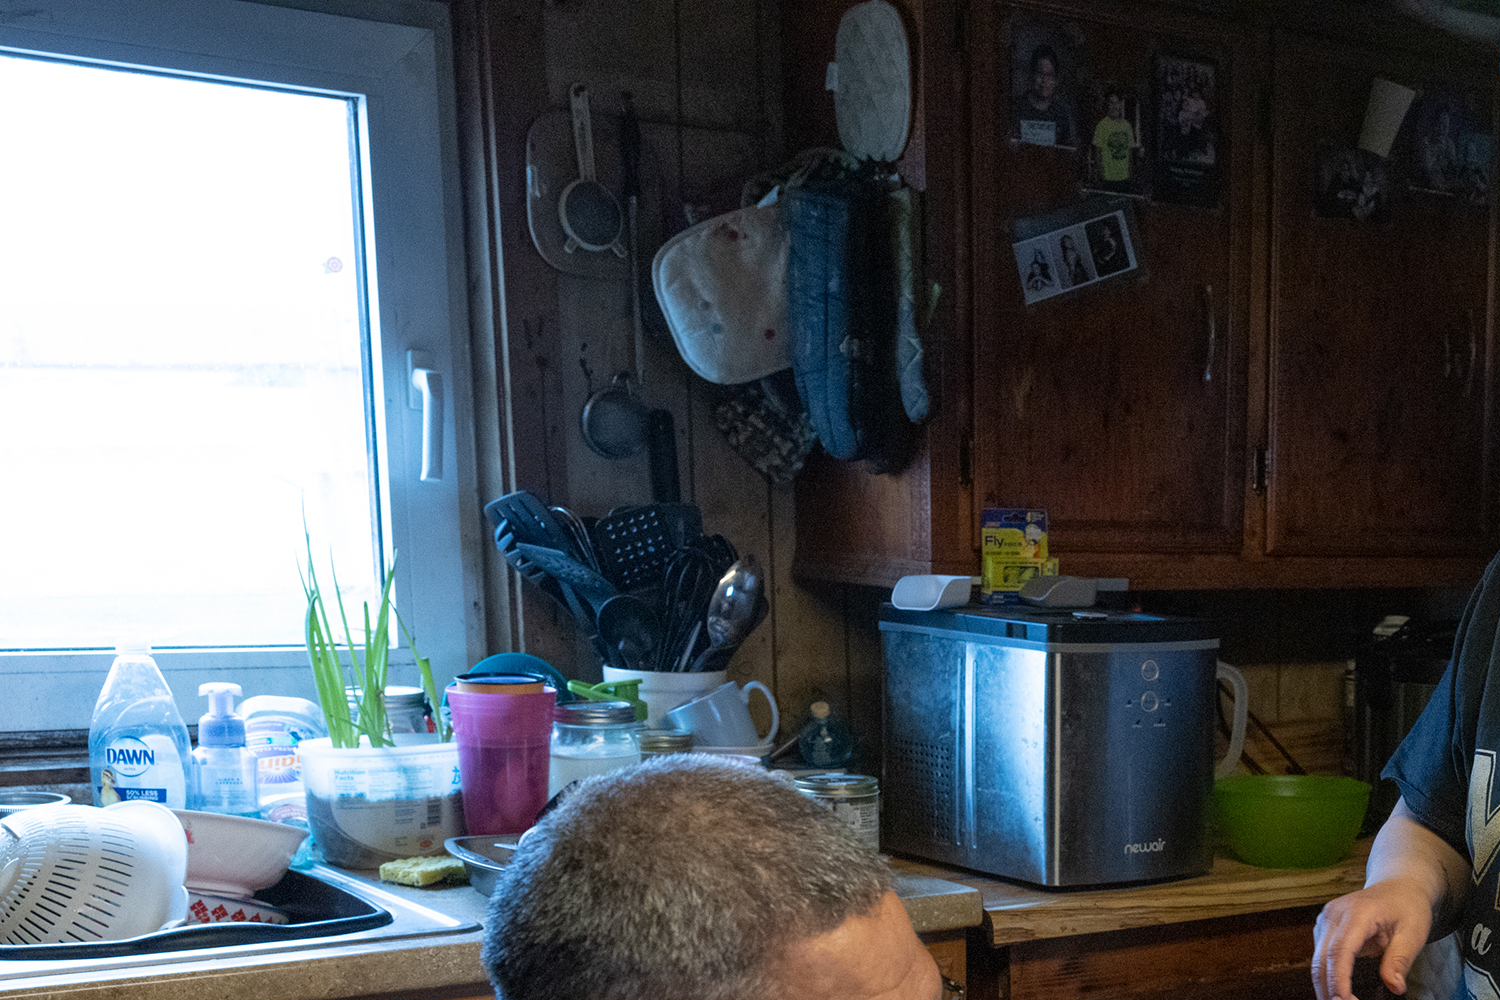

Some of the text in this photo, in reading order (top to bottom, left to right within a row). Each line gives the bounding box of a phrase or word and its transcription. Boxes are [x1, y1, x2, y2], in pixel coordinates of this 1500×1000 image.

[984, 535, 1004, 549] Fly
[106, 748, 155, 765] DAWN
[141, 789, 158, 797] LESS
[1124, 838, 1166, 854] newair
[1471, 923, 1492, 955] a
